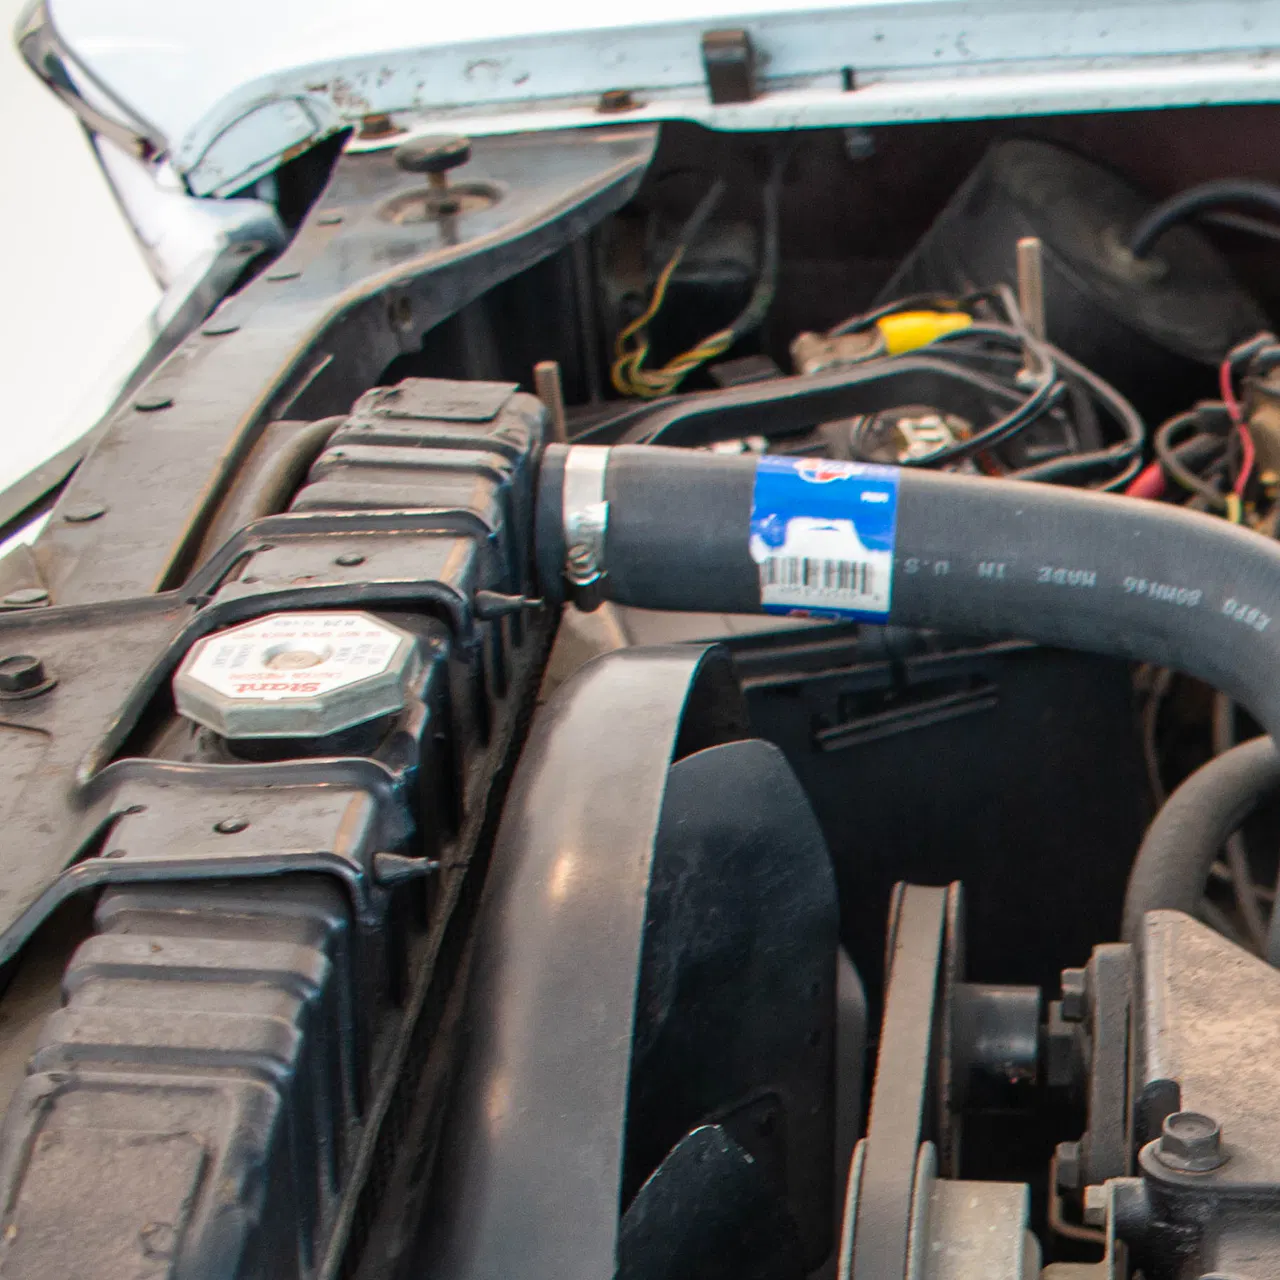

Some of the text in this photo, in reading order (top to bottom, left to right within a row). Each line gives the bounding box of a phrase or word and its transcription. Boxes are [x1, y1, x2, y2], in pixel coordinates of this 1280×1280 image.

[977, 561, 1008, 580] IN
[1037, 565, 1097, 587] MADE
[231, 681, 322, 694] Stant
